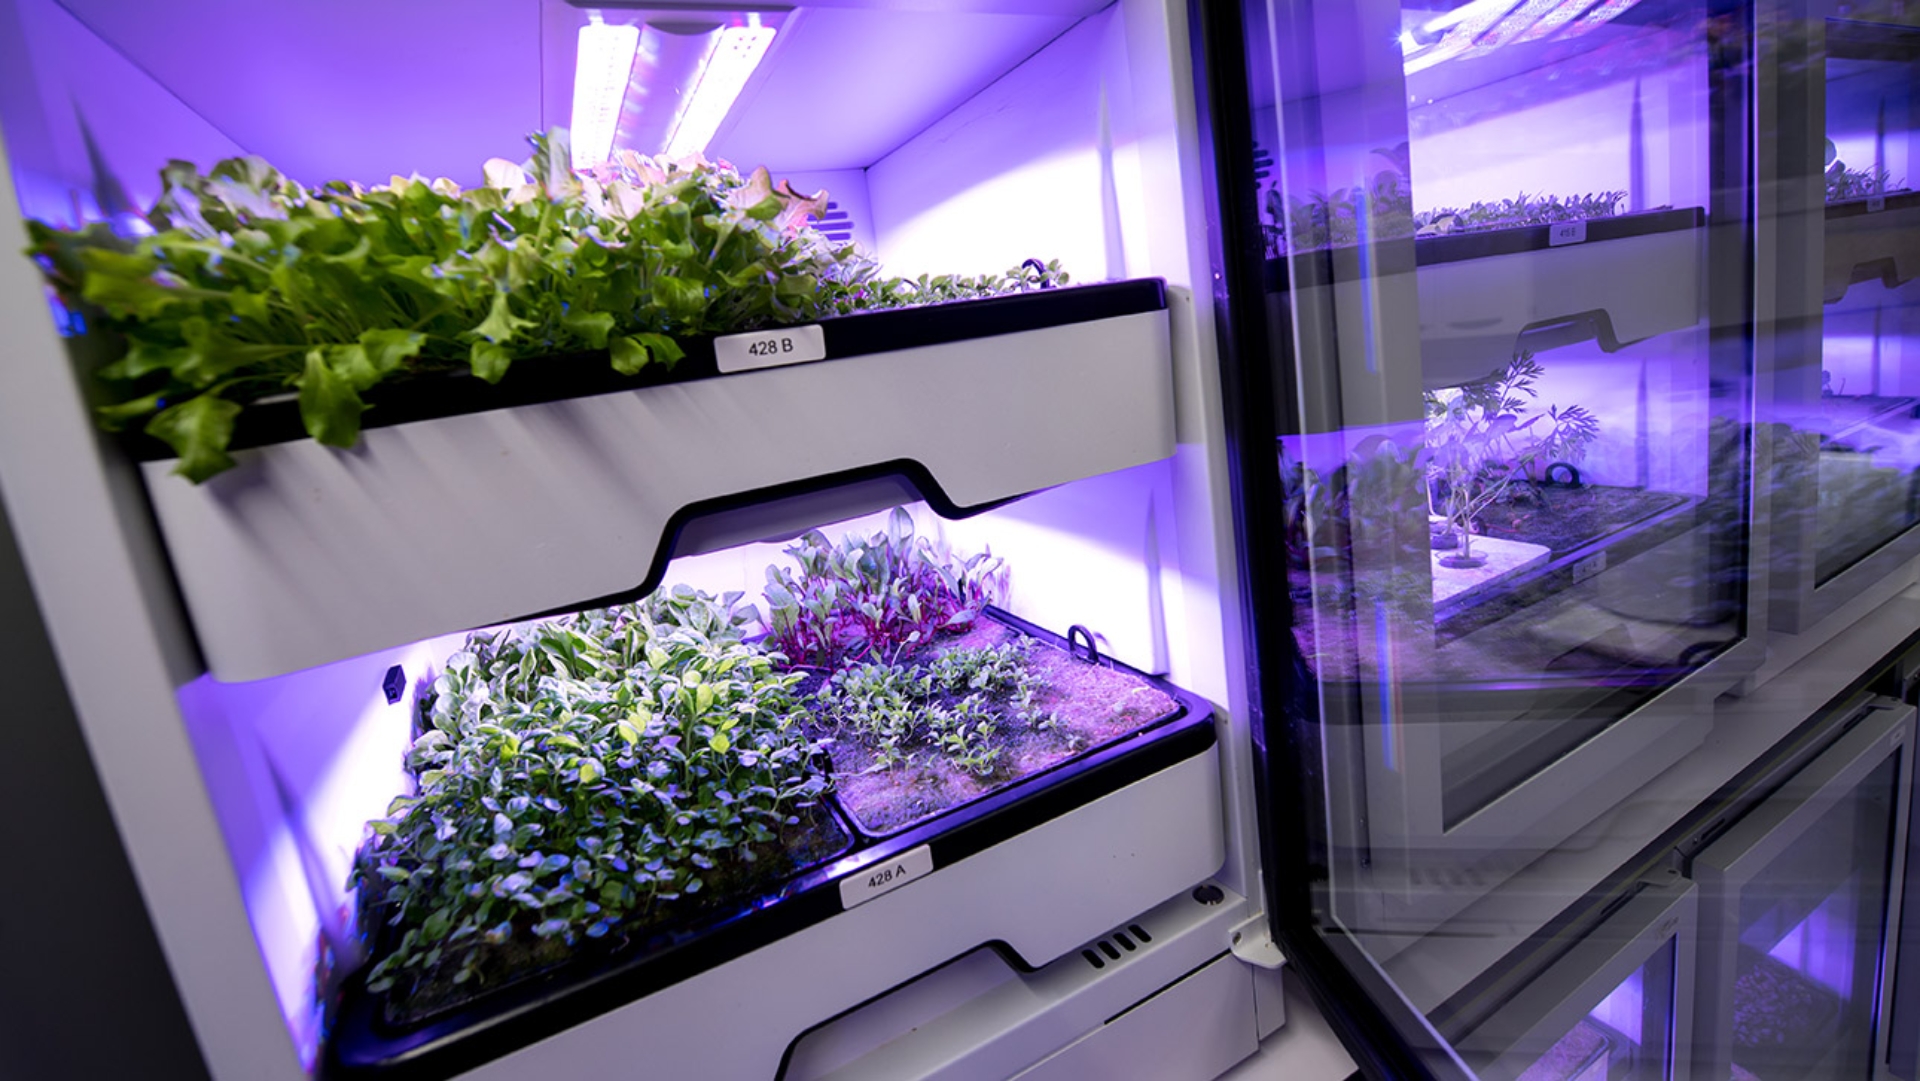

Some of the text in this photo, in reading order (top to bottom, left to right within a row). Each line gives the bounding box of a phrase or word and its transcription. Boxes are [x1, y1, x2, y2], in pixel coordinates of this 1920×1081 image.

[749, 338, 794, 356] 428 B
[868, 864, 907, 888] 428 A
